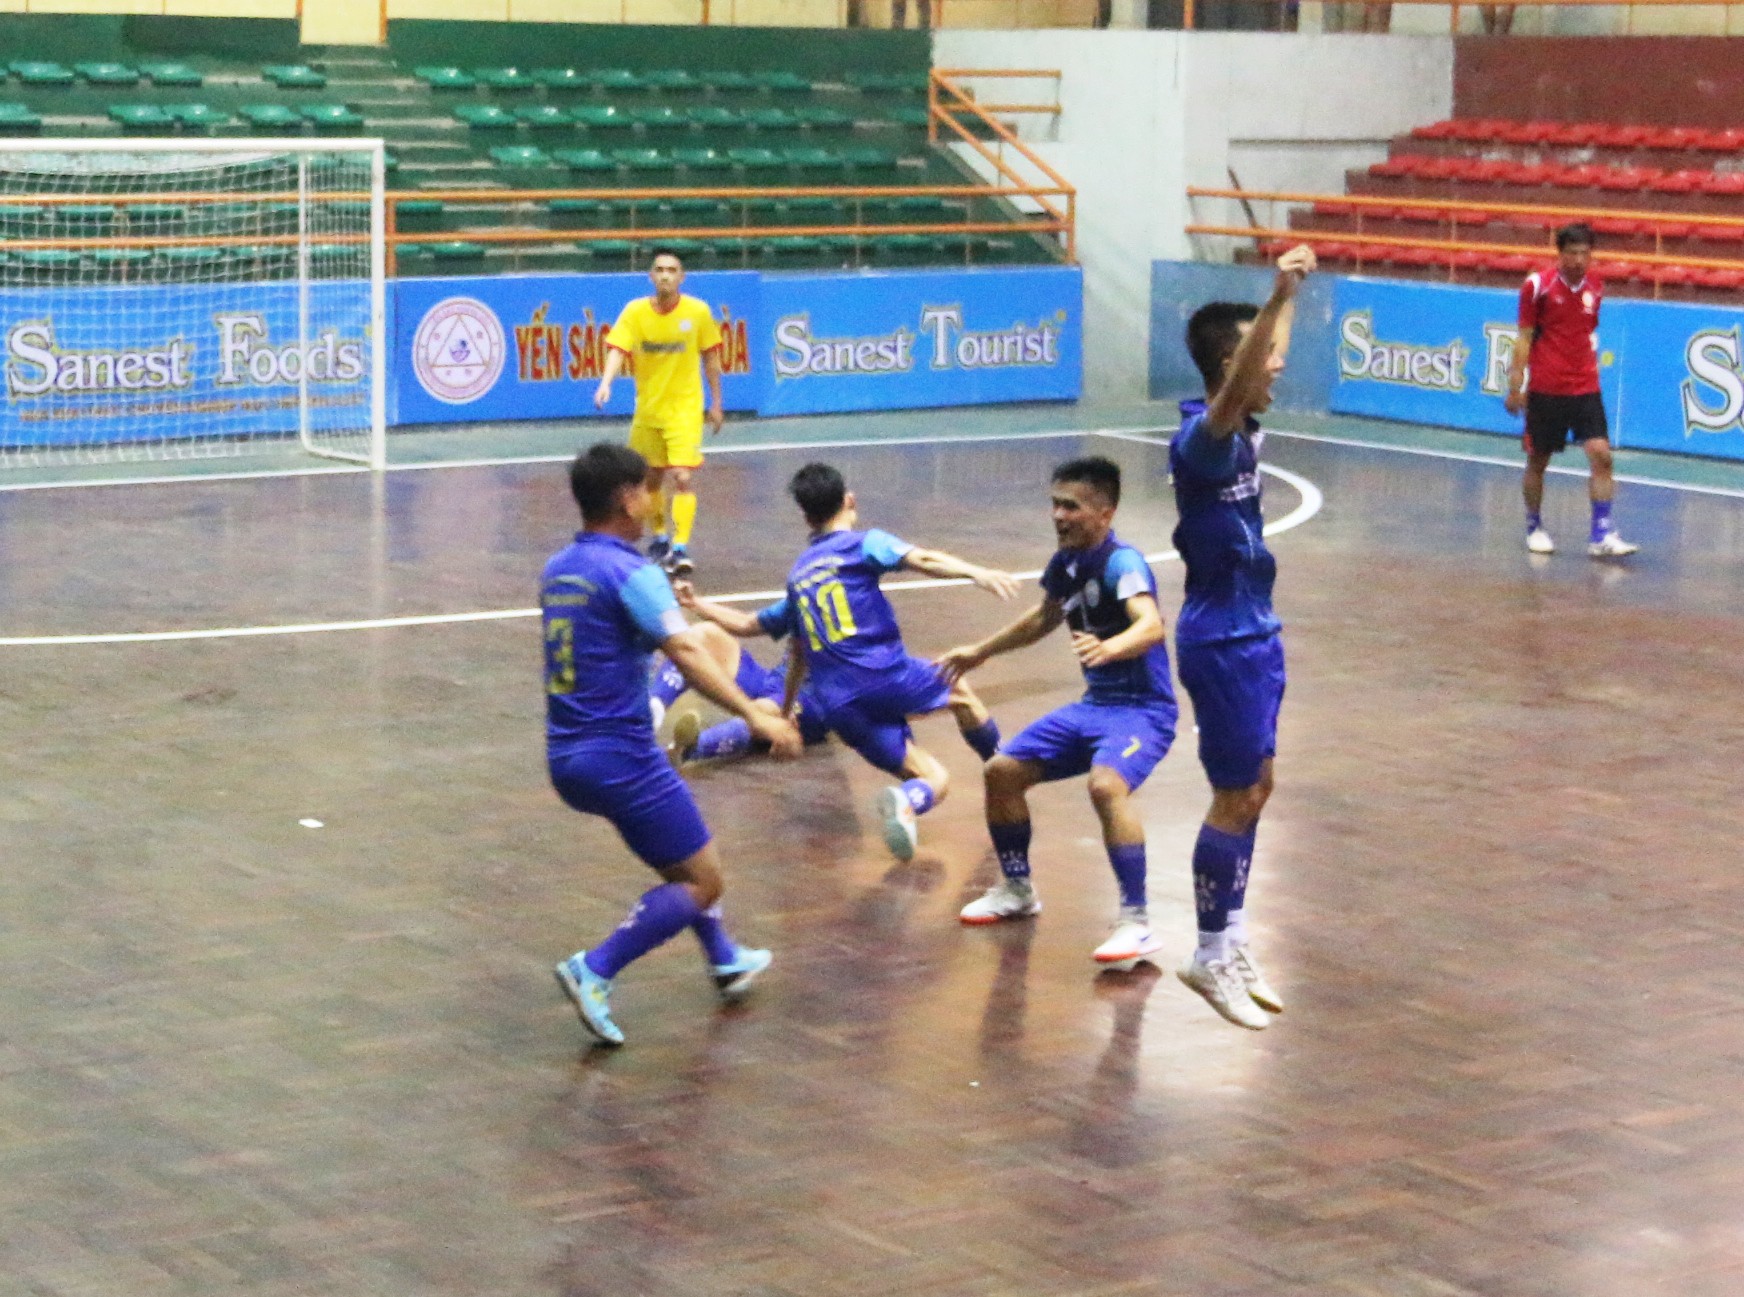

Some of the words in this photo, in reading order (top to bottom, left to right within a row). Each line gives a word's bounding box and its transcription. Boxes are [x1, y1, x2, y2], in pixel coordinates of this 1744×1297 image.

[8, 319, 192, 397] Sanest
[215, 312, 364, 386] Foods
[514, 301, 562, 381] YẾN
[774, 312, 914, 381] Sanest
[921, 304, 1058, 370] Tourist
[1338, 310, 1467, 391] Sanest
[799, 580, 857, 651] 10
[548, 617, 576, 695] 3
